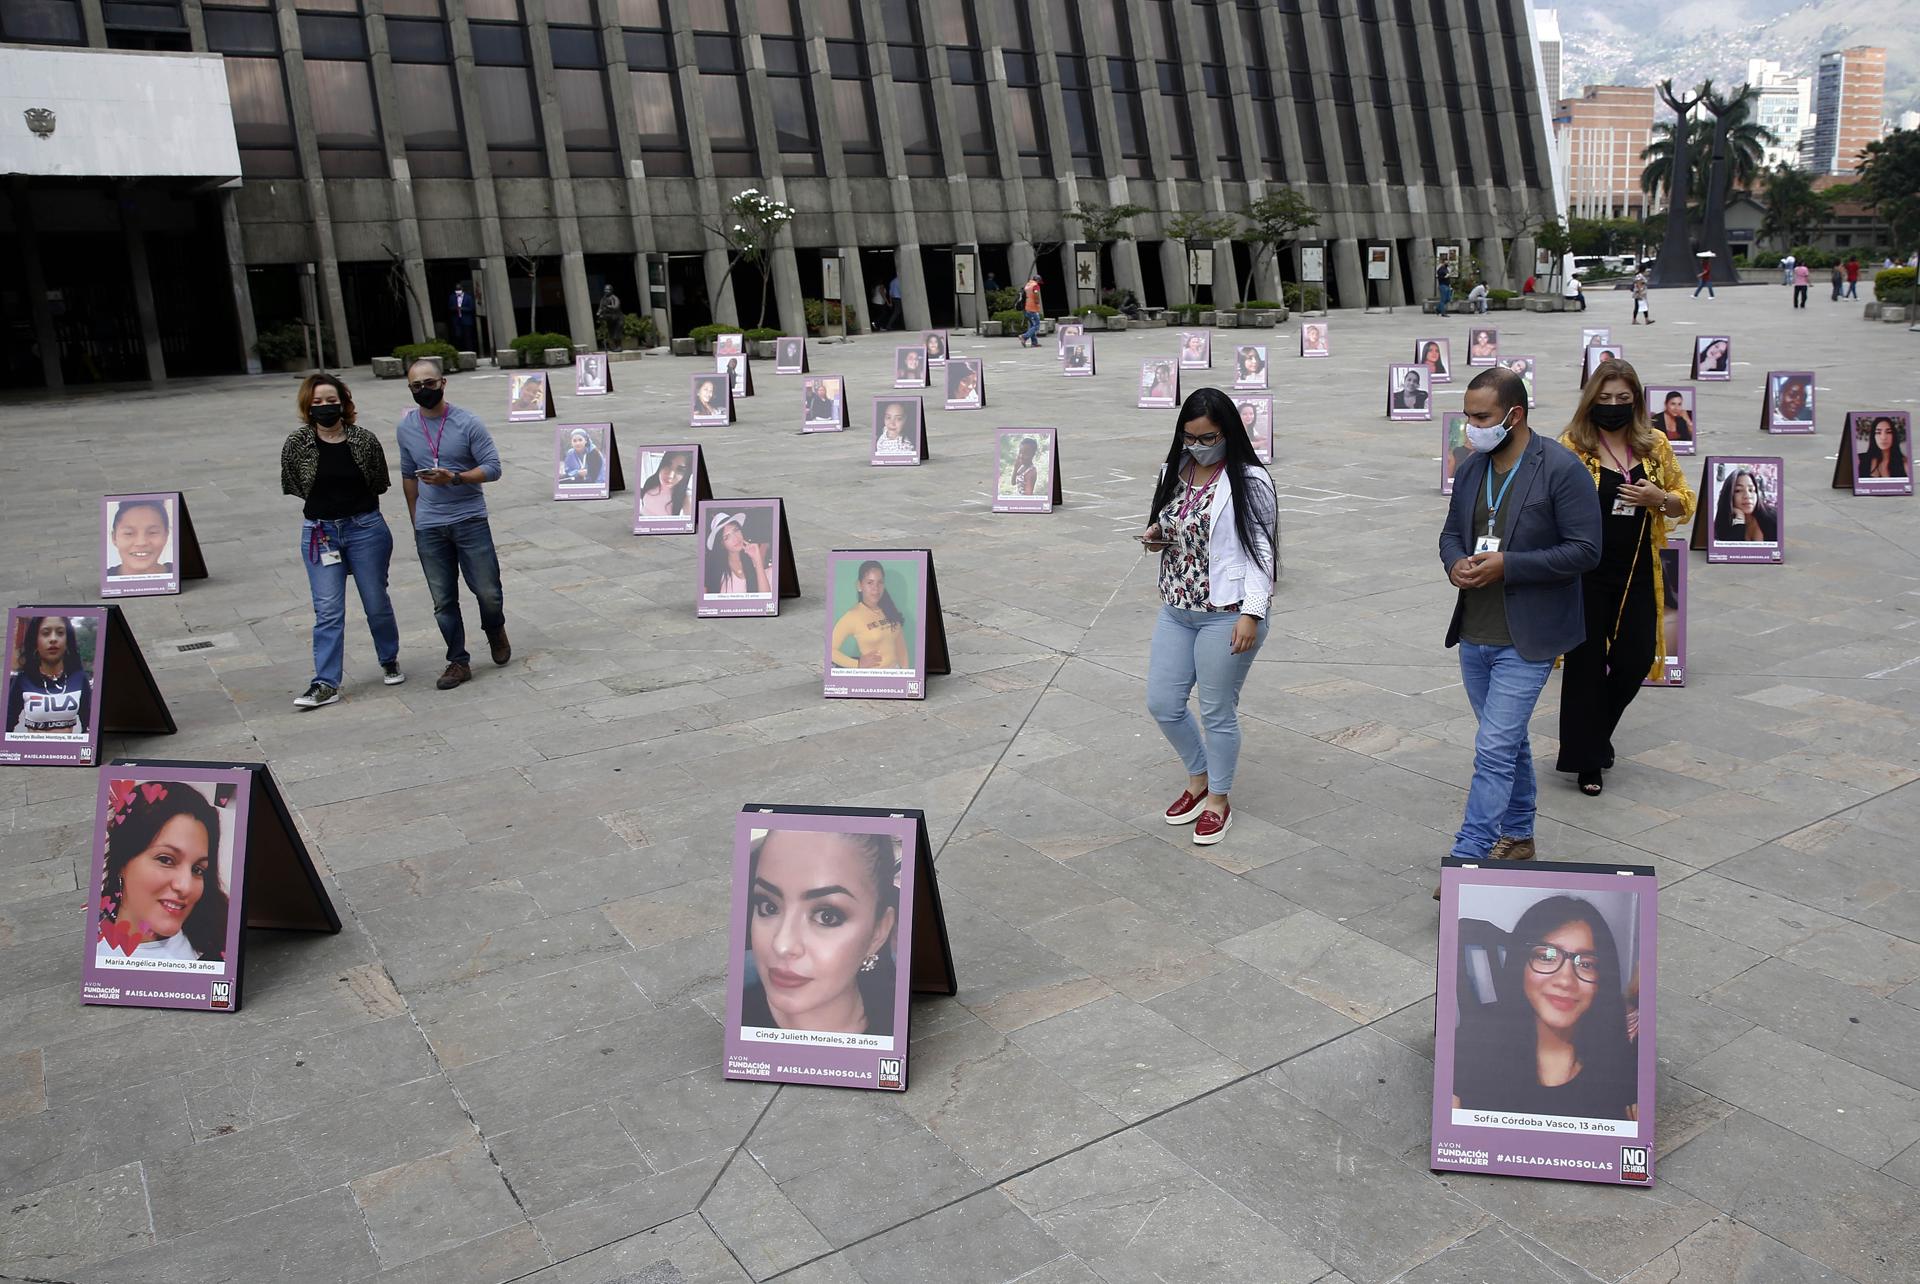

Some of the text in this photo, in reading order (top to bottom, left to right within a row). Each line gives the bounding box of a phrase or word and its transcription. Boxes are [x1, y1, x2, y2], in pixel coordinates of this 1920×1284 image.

[1670, 669, 1682, 677] NO
[29, 695, 78, 713] FILA
[81, 748, 91, 757] NO
[105, 958, 125, 966] María
[126, 959, 156, 969] Angélica
[157, 961, 187, 970] Polanco,
[198, 962, 215, 971] años
[84, 986, 120, 994] FUNDACIÓN
[125, 990, 206, 1000] #AISLADASNOSOLAS
[213, 983, 229, 996] NO
[755, 1031, 878, 1046] Cindy Julieth Morales, 28 años
[728, 1060, 771, 1070] FUNDACIÓN
[880, 1060, 900, 1075] NO
[745, 1068, 770, 1076] MUJER
[777, 1065, 872, 1079] #AISLADASNOSOLAS
[1474, 1115, 1616, 1132] Sofía Córdoba Vasco, 13 años
[1437, 1148, 1489, 1158] FUNDACIÓN
[1623, 1149, 1646, 1166] NO
[1459, 1157, 1489, 1166] MUJER
[1497, 1154, 1613, 1170] #AISLADASNOSOLAS
[1623, 1164, 1630, 1173] ES
